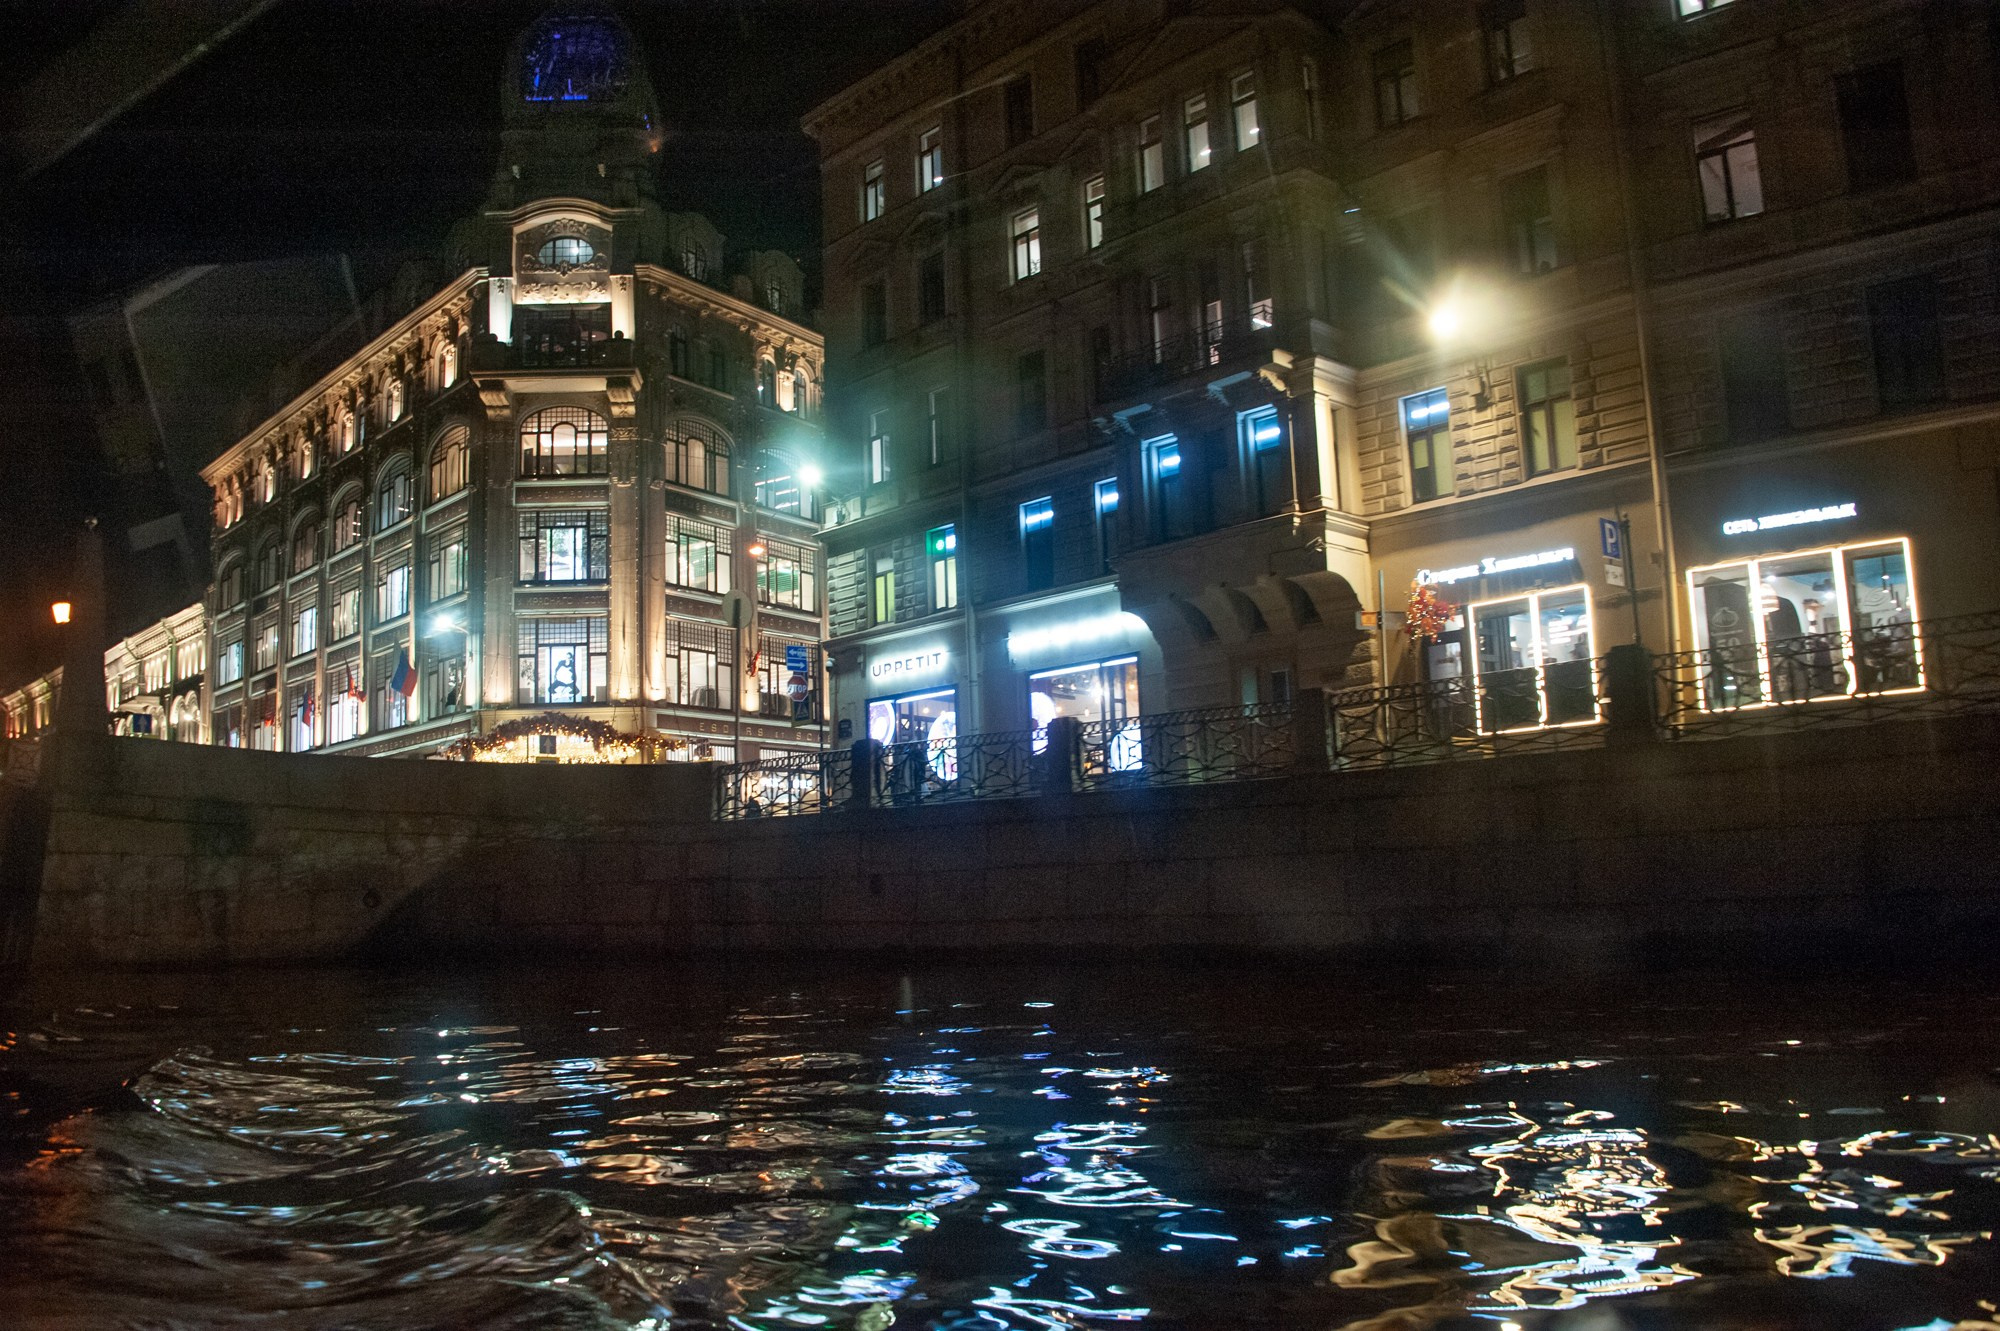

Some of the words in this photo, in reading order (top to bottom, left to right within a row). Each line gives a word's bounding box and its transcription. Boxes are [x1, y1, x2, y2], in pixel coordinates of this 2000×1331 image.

[1722, 518, 1759, 536] СЕТЬ
[1604, 522, 1617, 554] P
[872, 652, 942, 677] UPPETIT
[787, 683, 807, 695] STOP
[699, 722, 764, 737] ESDRS
